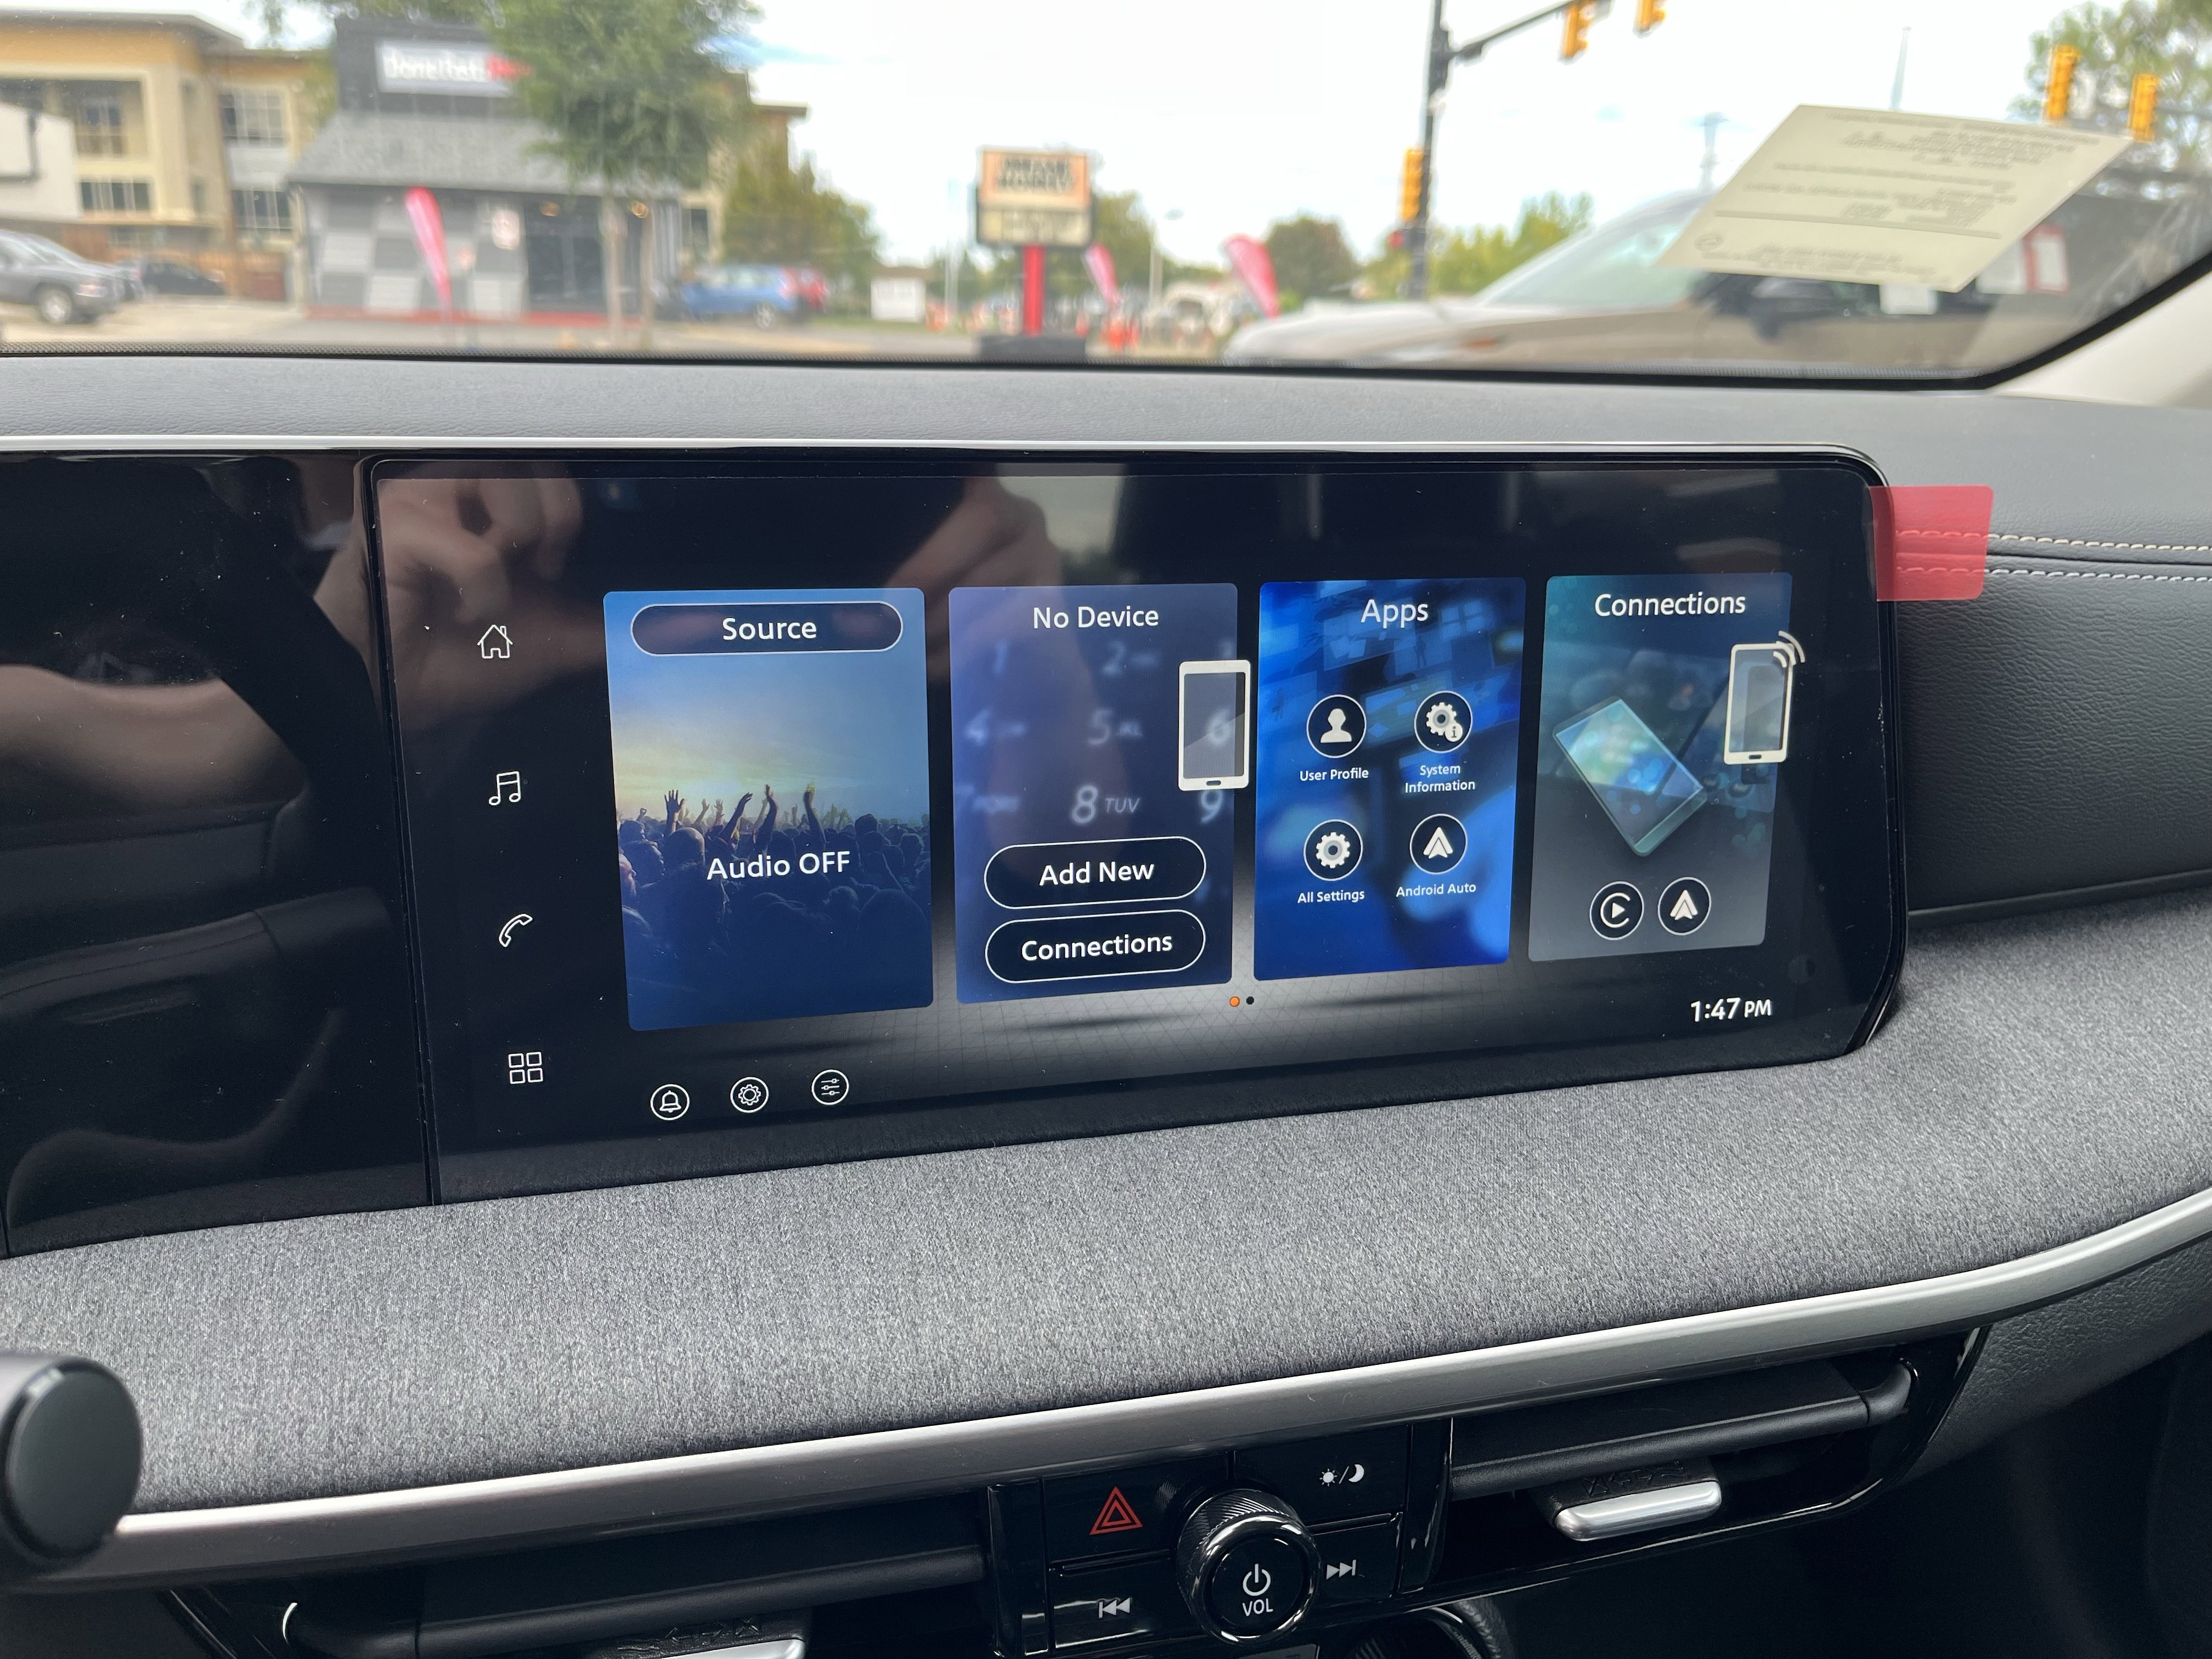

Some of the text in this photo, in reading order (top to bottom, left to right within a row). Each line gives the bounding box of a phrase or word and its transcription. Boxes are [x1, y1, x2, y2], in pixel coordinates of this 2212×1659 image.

[1360, 599, 1429, 629] Apps
[1594, 591, 1747, 617] Connections
[722, 617, 817, 641] Source
[1033, 605, 1159, 629] No Device
[1300, 767, 1369, 782] User Profile
[1419, 764, 1461, 778] System
[1404, 779, 1476, 793] Information
[1071, 783, 1099, 825] 8
[1104, 797, 1141, 814] TUV
[707, 850, 850, 880] Audio OFF
[1039, 861, 1155, 887] Add New
[1297, 889, 1365, 904] All Settings
[1395, 882, 1477, 898] Android Auto
[1021, 933, 1173, 961] Connections
[1690, 997, 1772, 1023] 1:47 PM
[1242, 1598, 1274, 1617] VOL
